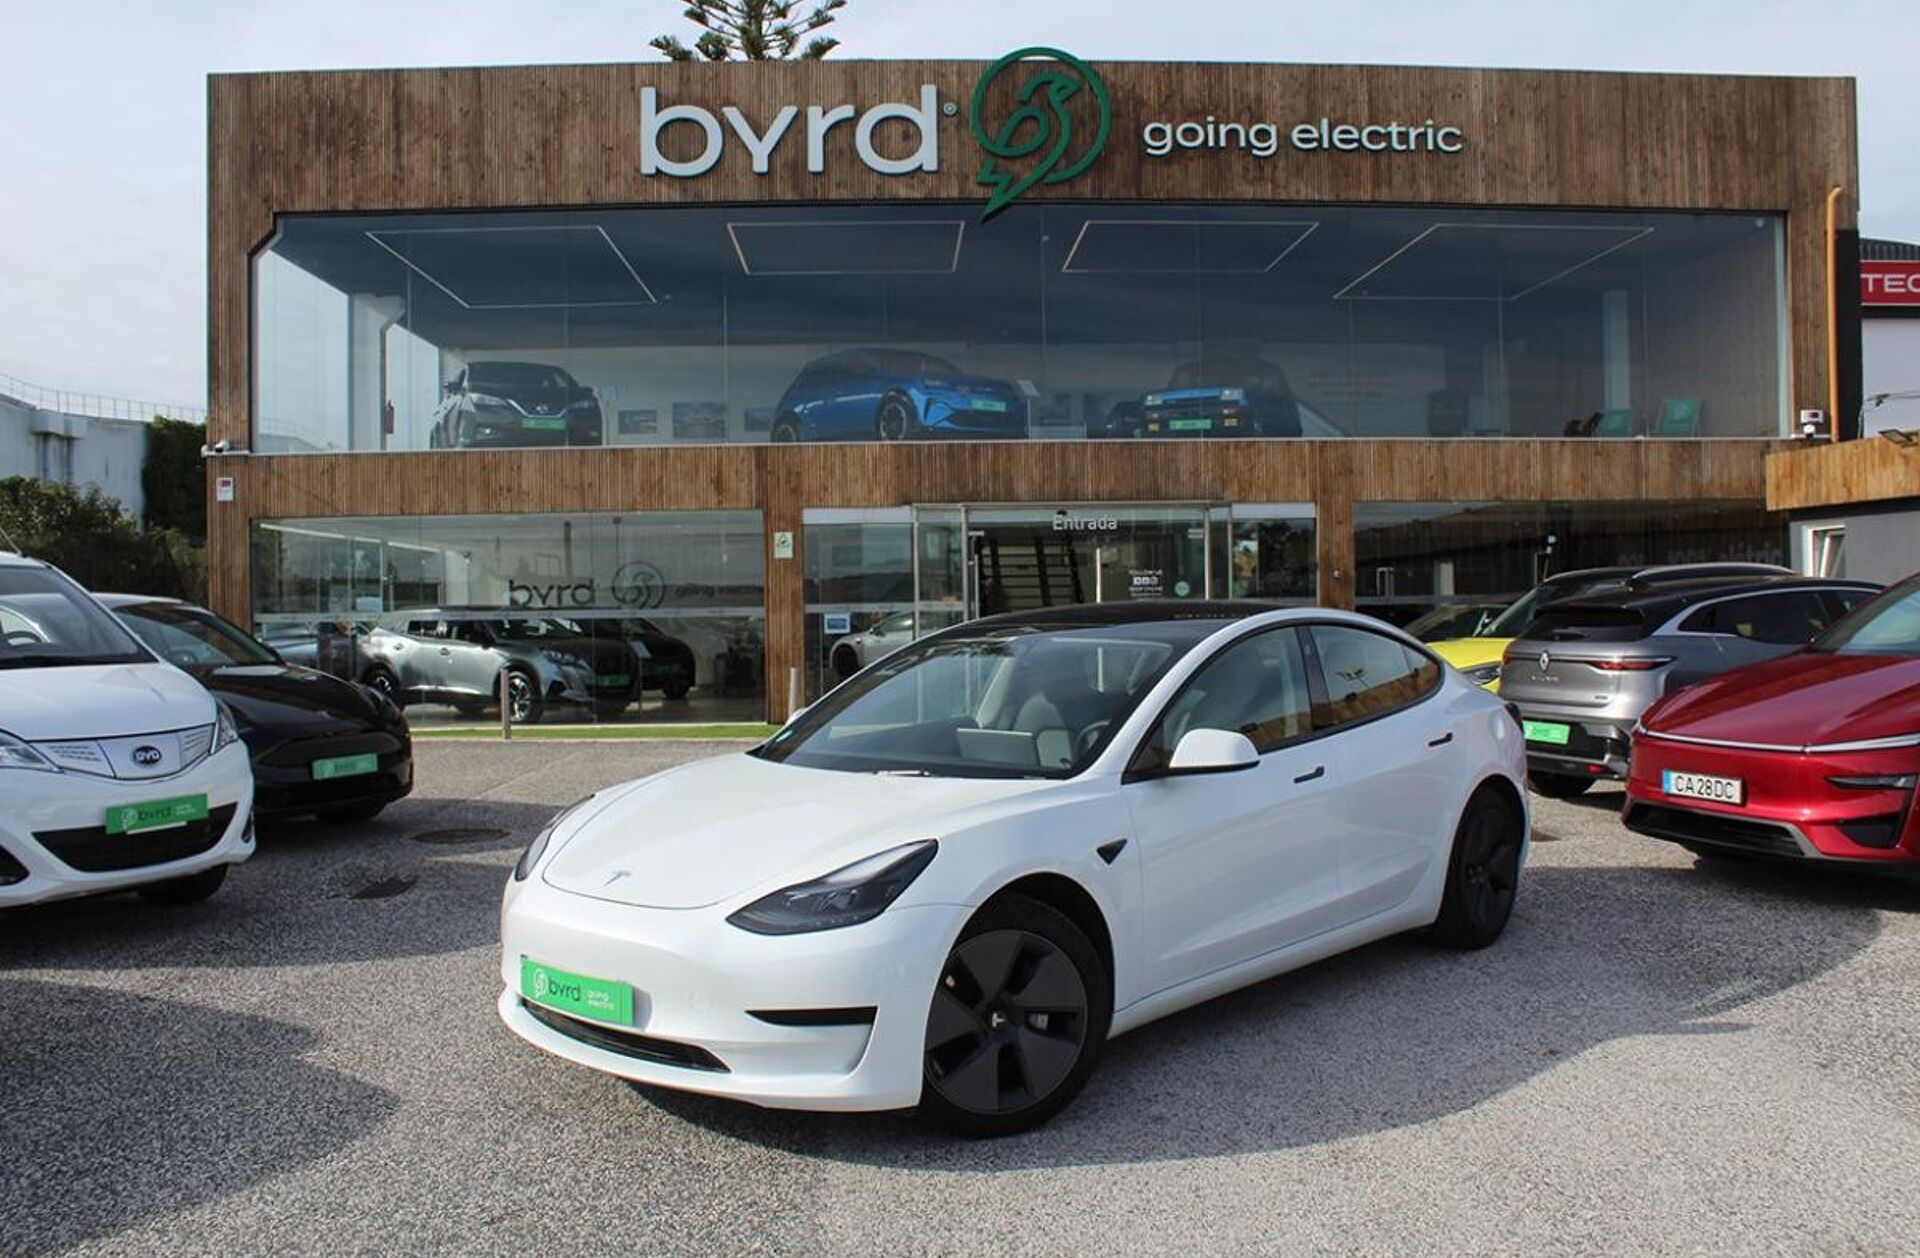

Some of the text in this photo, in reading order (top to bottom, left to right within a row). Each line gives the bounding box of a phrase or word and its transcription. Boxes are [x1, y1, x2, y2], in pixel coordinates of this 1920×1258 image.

[640, 84, 939, 177] byrd
[1143, 116, 1463, 156] going electric
[1052, 514, 1118, 530] Entrada
[509, 578, 596, 606] byrd
[548, 976, 581, 1002] byrd
